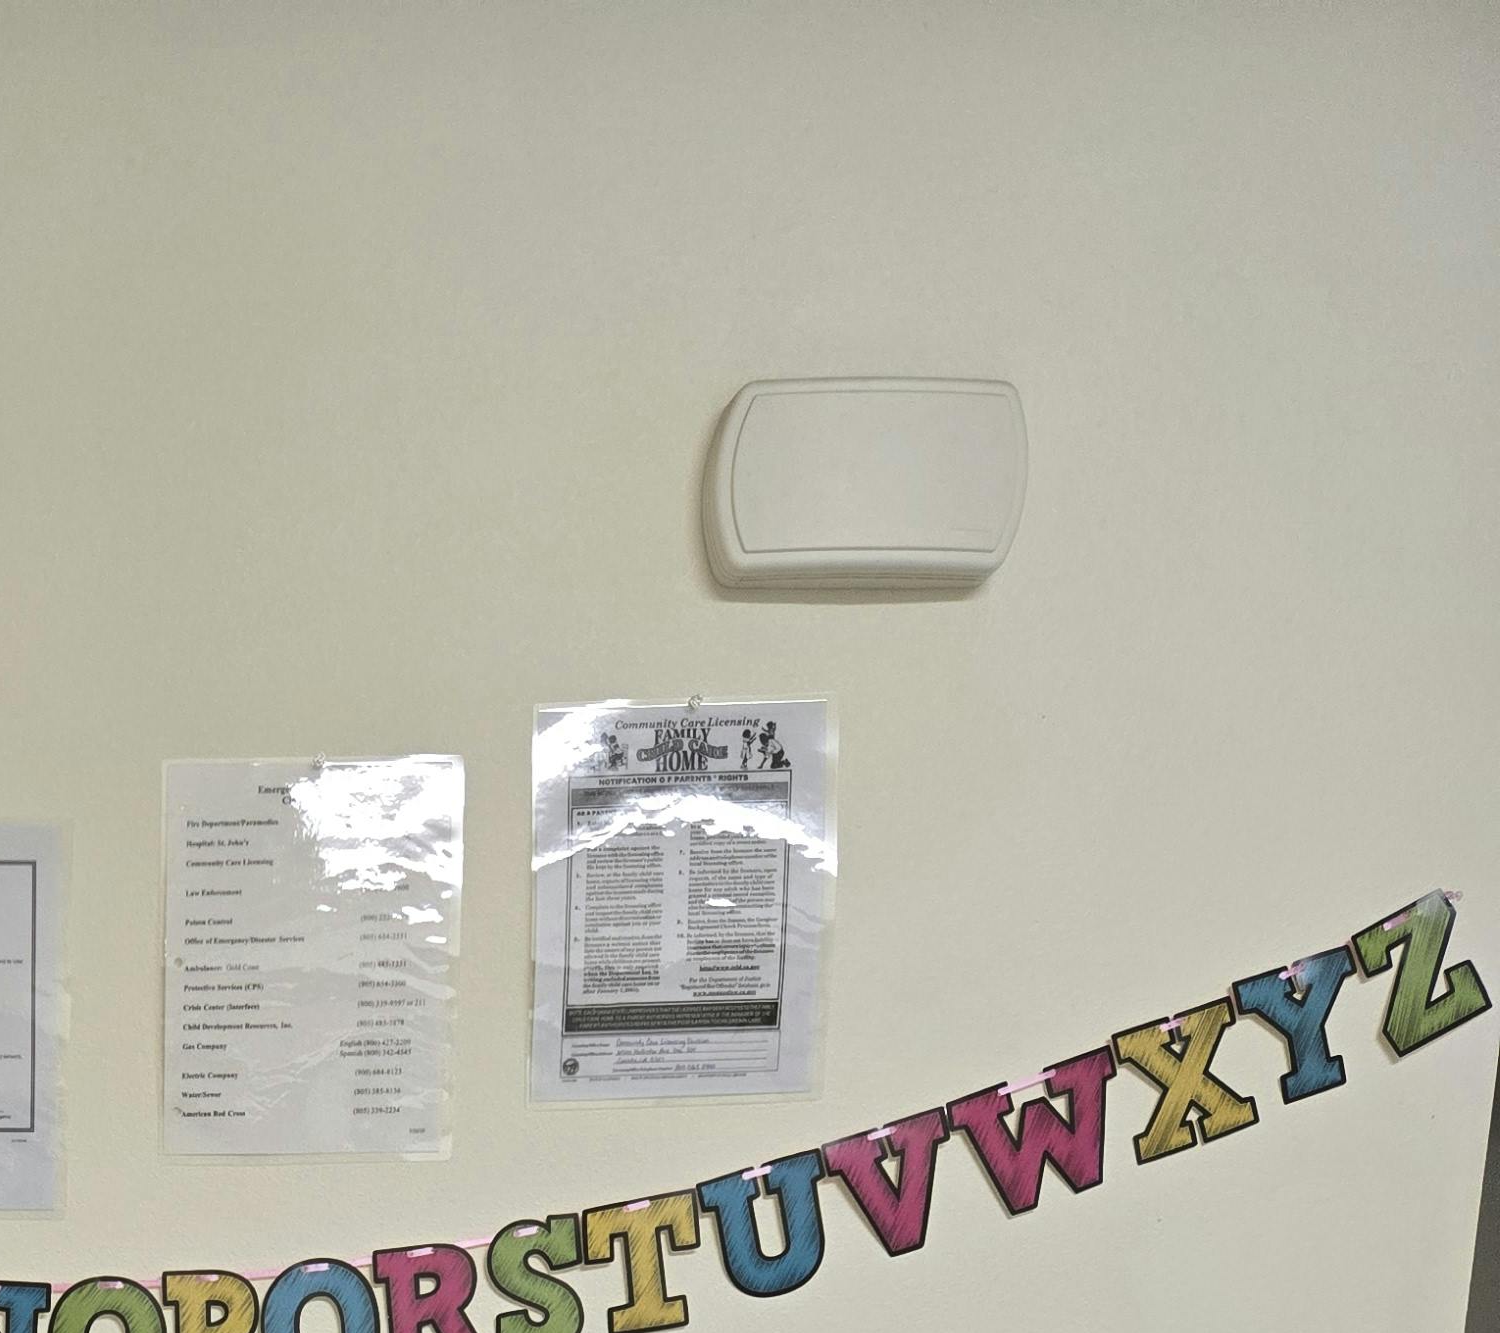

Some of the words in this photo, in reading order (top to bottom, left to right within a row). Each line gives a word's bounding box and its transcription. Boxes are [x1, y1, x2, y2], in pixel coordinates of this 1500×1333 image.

[615, 719, 677, 731] Community
[680, 718, 705, 729] Care
[707, 717, 760, 729] Licensing
[654, 728, 711, 745] FAMILY
[655, 750, 708, 772] HOME
[599, 776, 657, 785] NOTIFICATION
